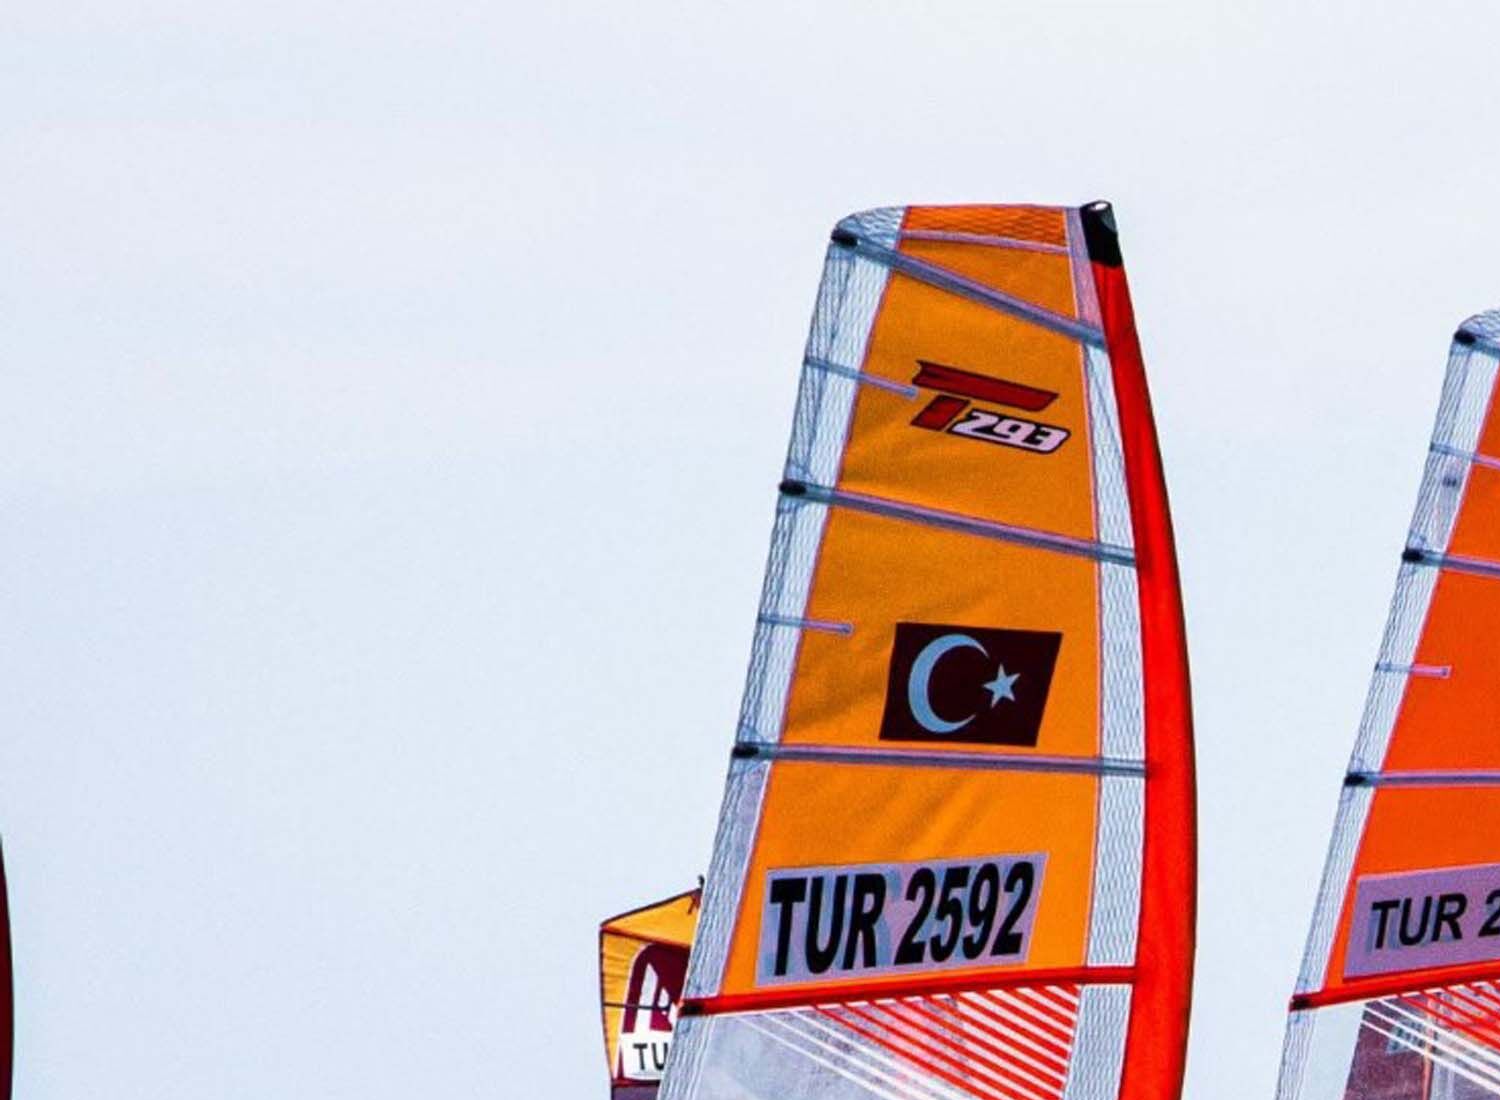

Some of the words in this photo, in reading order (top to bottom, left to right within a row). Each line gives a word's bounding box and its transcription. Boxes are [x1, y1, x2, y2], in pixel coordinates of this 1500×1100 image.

[769, 872, 887, 976] TUR
[894, 861, 1035, 965] 2592
[1371, 893, 1468, 949] TUR
